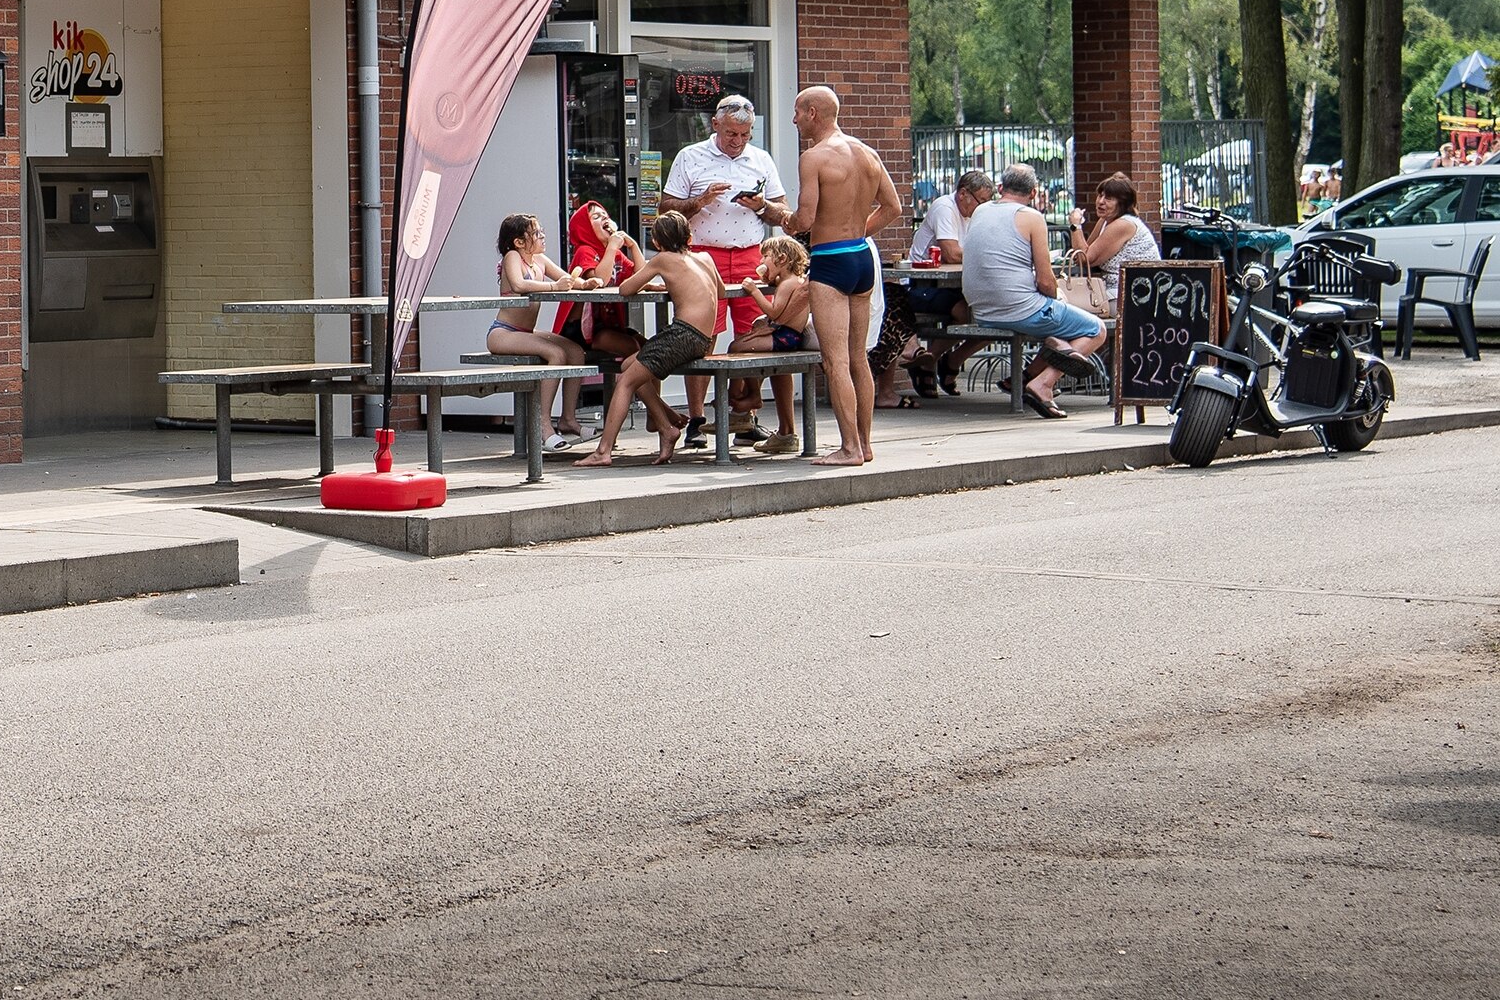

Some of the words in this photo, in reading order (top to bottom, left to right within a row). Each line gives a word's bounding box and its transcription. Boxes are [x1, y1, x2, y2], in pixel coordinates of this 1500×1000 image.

[53, 20, 85, 51] kik
[29, 50, 85, 103] shop
[86, 51, 120, 89] 24
[675, 74, 721, 95] OPEN
[412, 187, 433, 247] MAGNUM
[1139, 323, 1190, 349] 13.00
